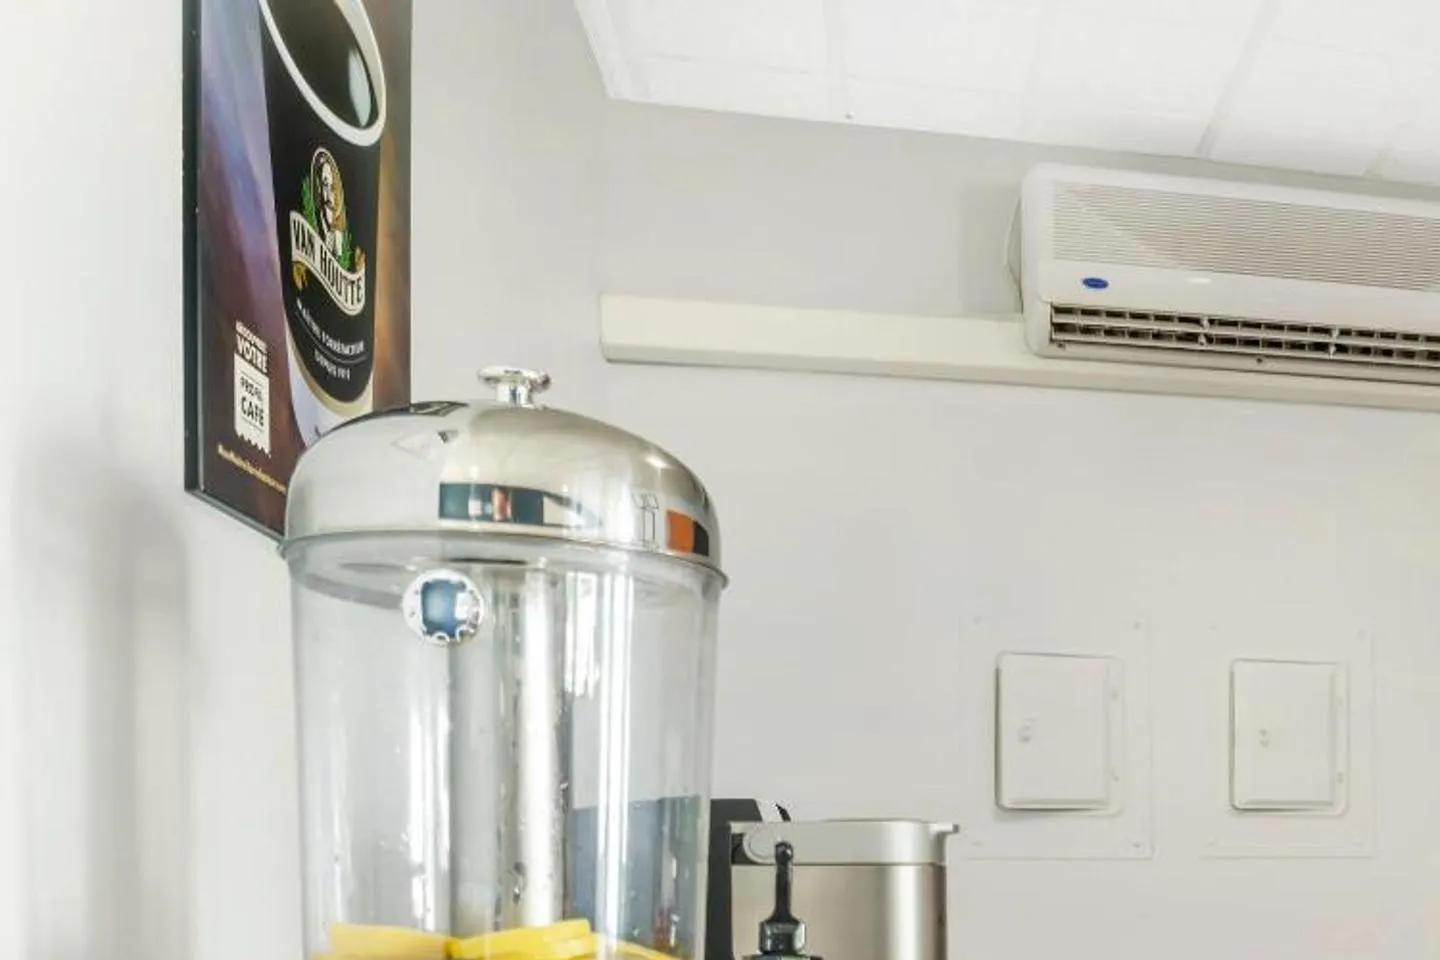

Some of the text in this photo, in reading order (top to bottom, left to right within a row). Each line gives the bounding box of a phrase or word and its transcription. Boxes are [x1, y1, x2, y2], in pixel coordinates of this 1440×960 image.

[293, 218, 364, 306] VAN HOUTTE
[236, 333, 268, 373] VOTRE
